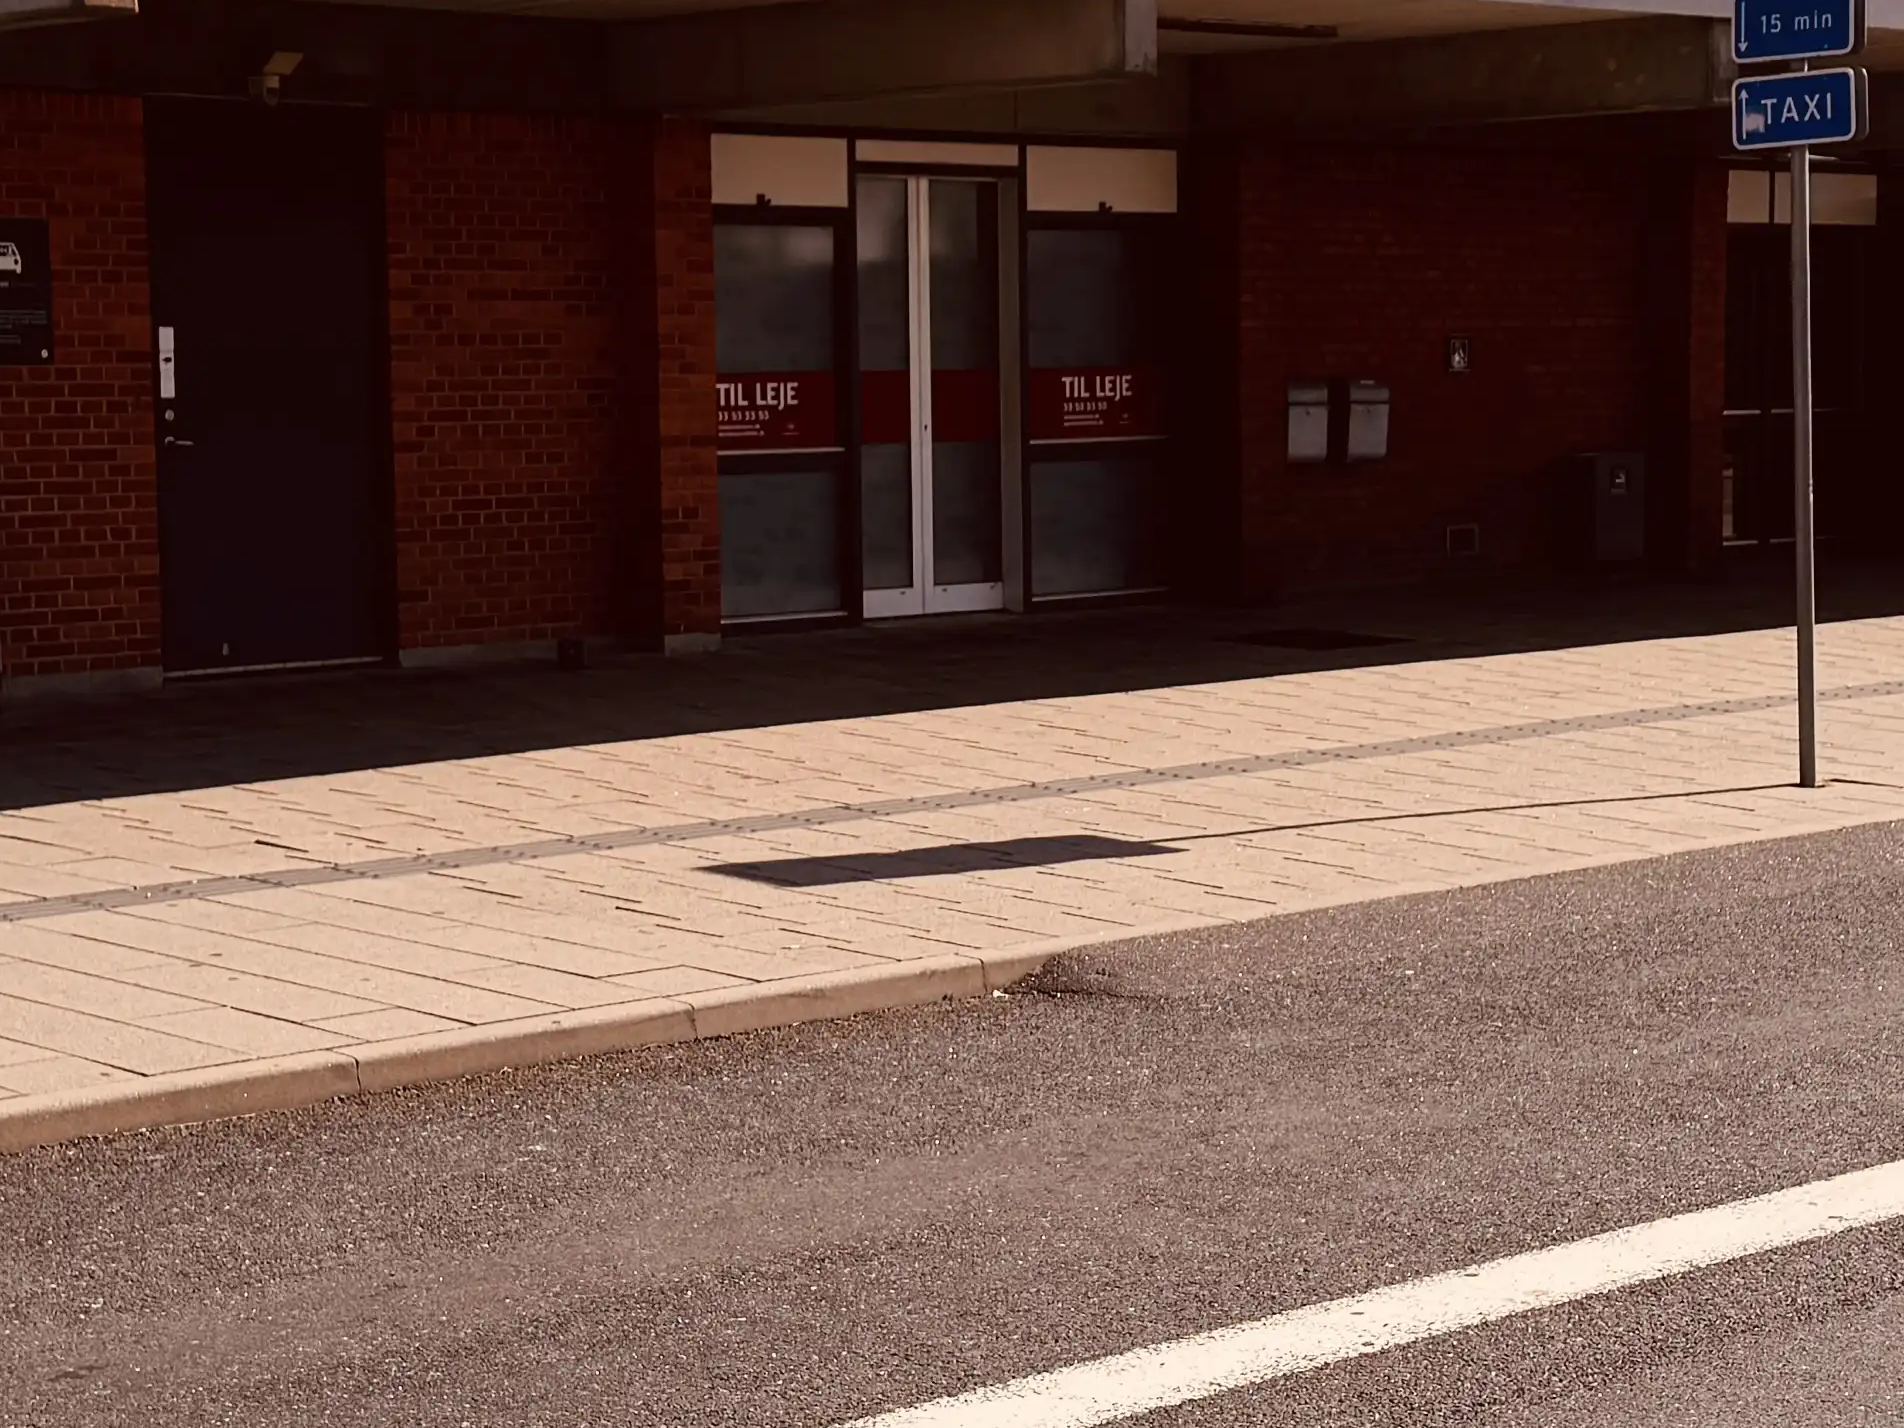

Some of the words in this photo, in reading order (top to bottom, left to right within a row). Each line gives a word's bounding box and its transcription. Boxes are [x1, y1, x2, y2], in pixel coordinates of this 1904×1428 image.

[1760, 14, 1782, 34] 15
[1794, 10, 1832, 31] min
[1760, 92, 1832, 125] TAXI
[715, 383, 749, 407] TIL
[755, 381, 800, 411] LEJE
[1061, 376, 1090, 399] TIL
[1095, 374, 1133, 402] LEJE
